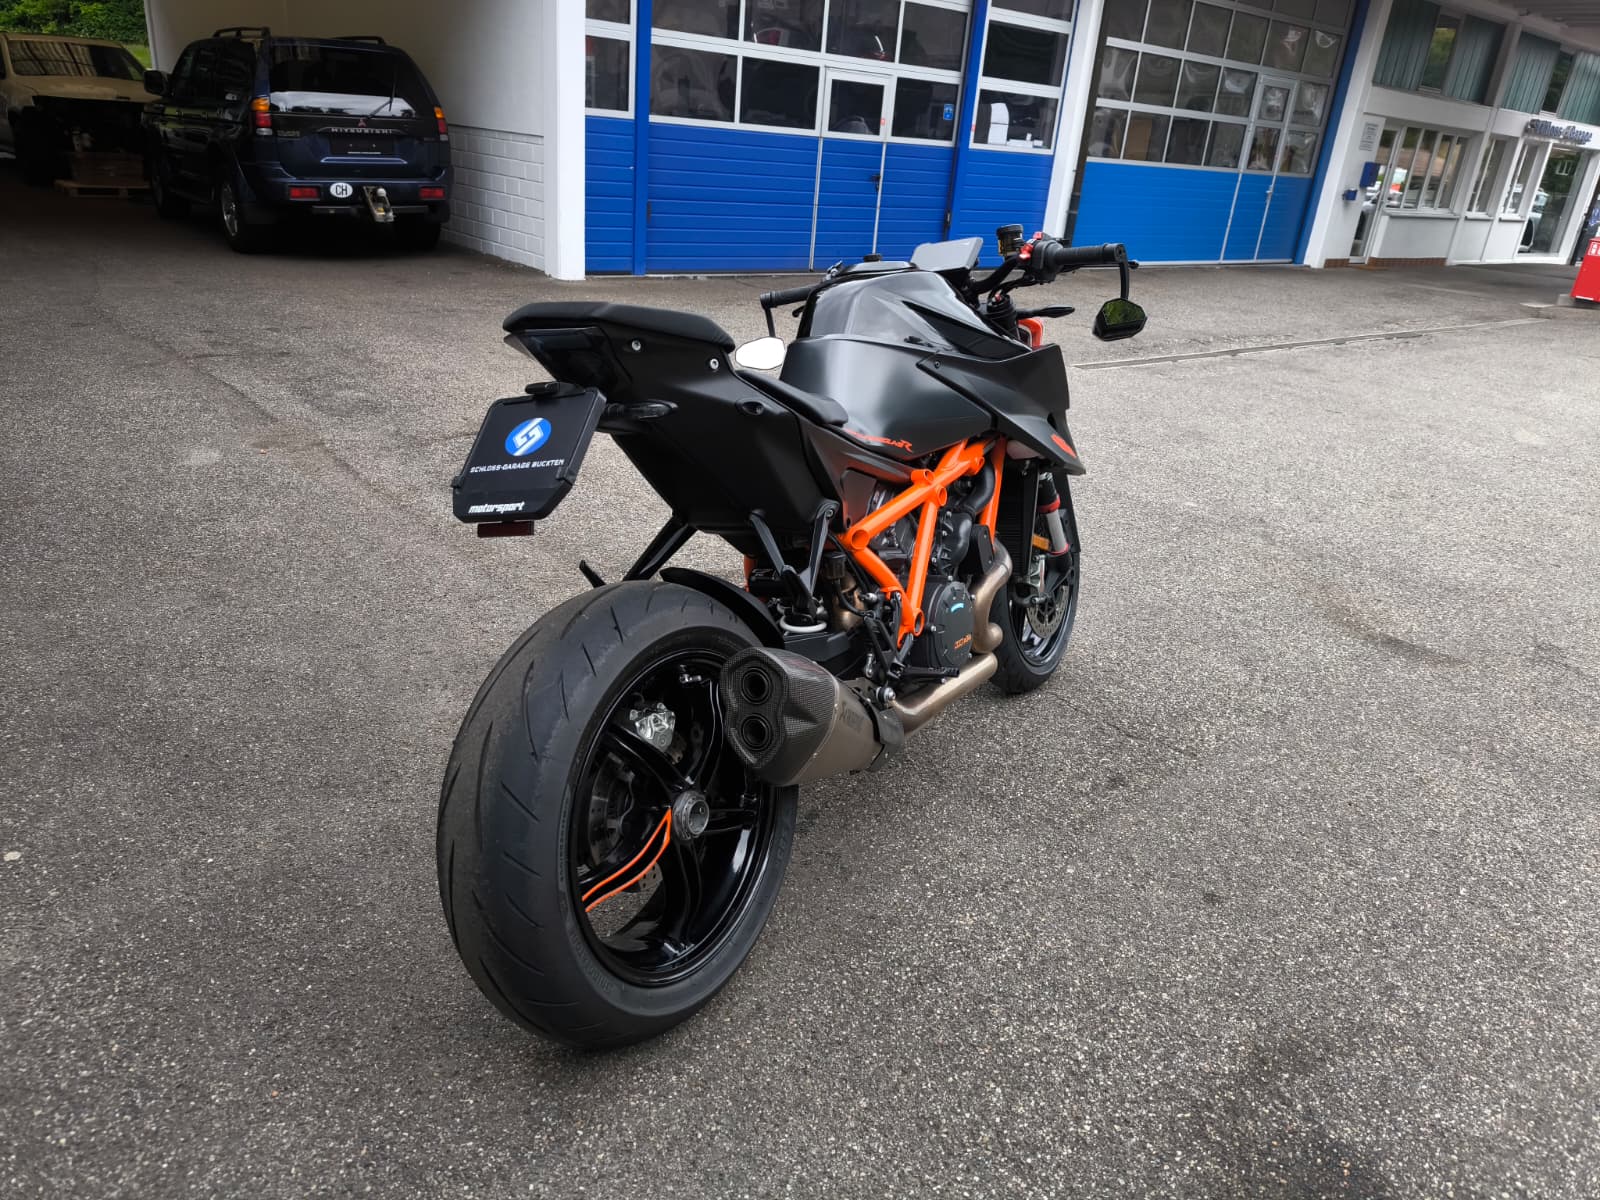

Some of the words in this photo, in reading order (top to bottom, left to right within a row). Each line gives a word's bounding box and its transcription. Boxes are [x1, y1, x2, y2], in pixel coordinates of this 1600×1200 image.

[335, 184, 348, 197] CH
[470, 461, 531, 473] SCHLOSS-GARAGE
[531, 459, 565, 468] BUCKTEN
[468, 501, 525, 514] motorsport
